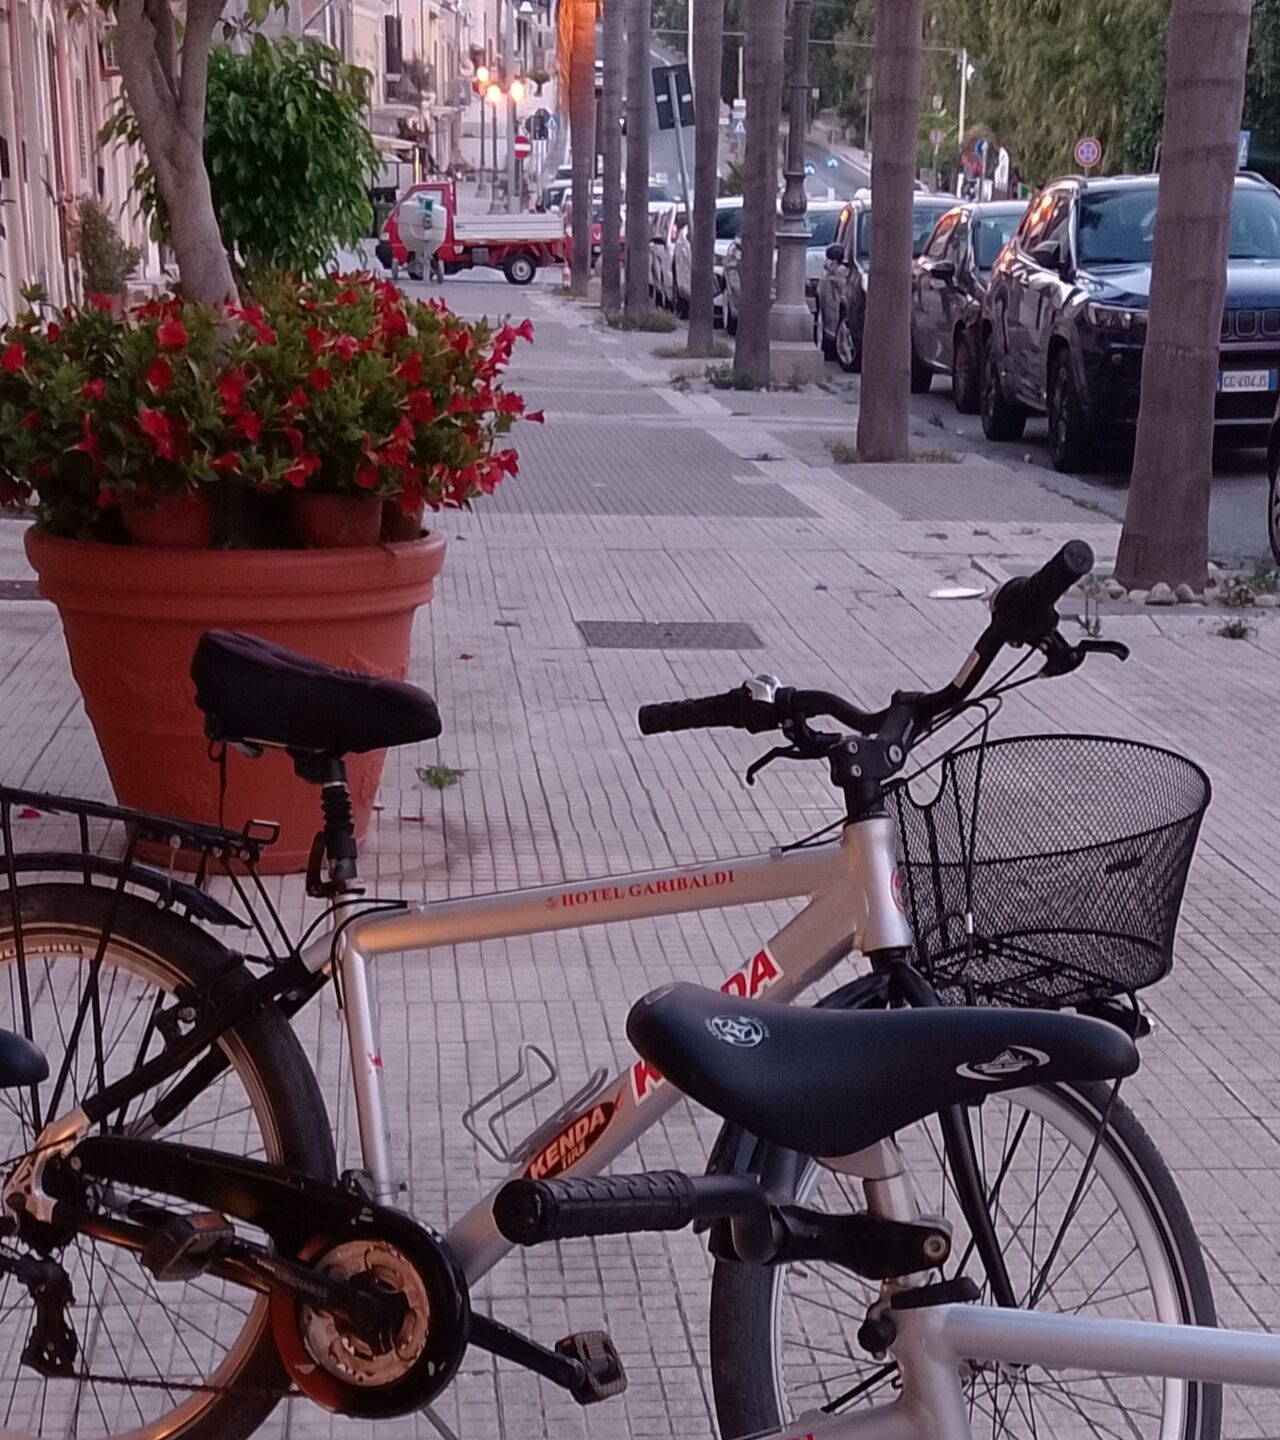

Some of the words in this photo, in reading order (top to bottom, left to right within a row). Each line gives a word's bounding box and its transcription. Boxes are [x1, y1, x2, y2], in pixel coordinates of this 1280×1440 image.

[560, 885, 625, 908] HOTEL
[628, 869, 736, 899] GARIBALDI
[529, 1105, 607, 1181] KENDA
